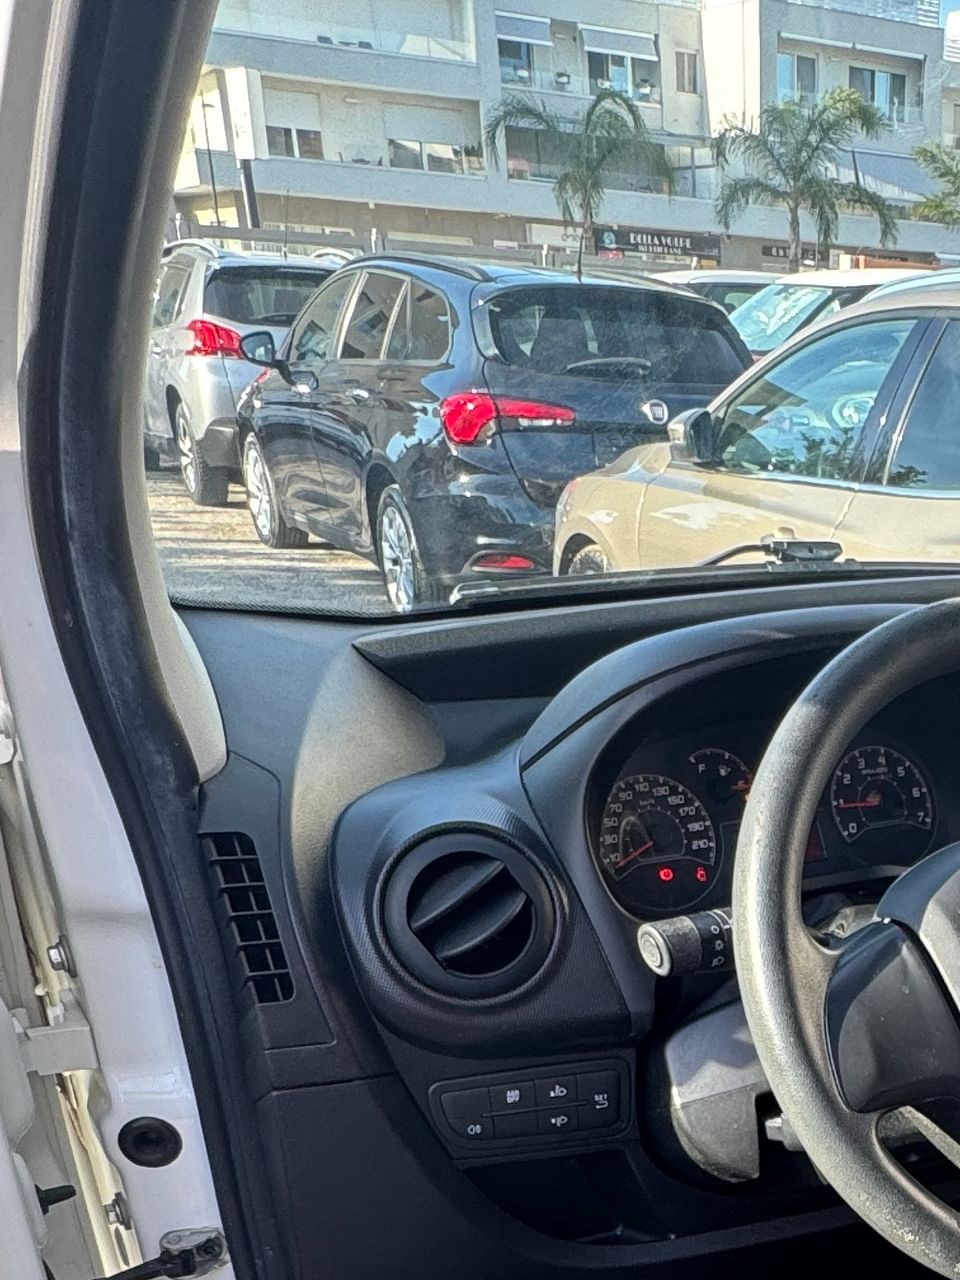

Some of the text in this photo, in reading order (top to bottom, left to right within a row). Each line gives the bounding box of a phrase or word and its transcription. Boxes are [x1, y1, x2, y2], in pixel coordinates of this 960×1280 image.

[857, 758, 865, 769] 3
[878, 755, 886, 766] 4
[896, 766, 905, 777] 5
[843, 773, 851, 784] 2
[634, 782, 649, 792] 110
[652, 786, 670, 796] 130
[912, 787, 920, 798] 6
[618, 791, 633, 801] 90
[667, 794, 685, 805] 150
[609, 803, 622, 813] 70
[679, 806, 696, 816] 170
[603, 816, 618, 827] 50
[917, 812, 925, 822] 7
[687, 821, 705, 832] 190
[848, 822, 857, 833] 0
[603, 834, 618, 845] 30
[691, 839, 709, 850] 210
[609, 853, 621, 862] 10
